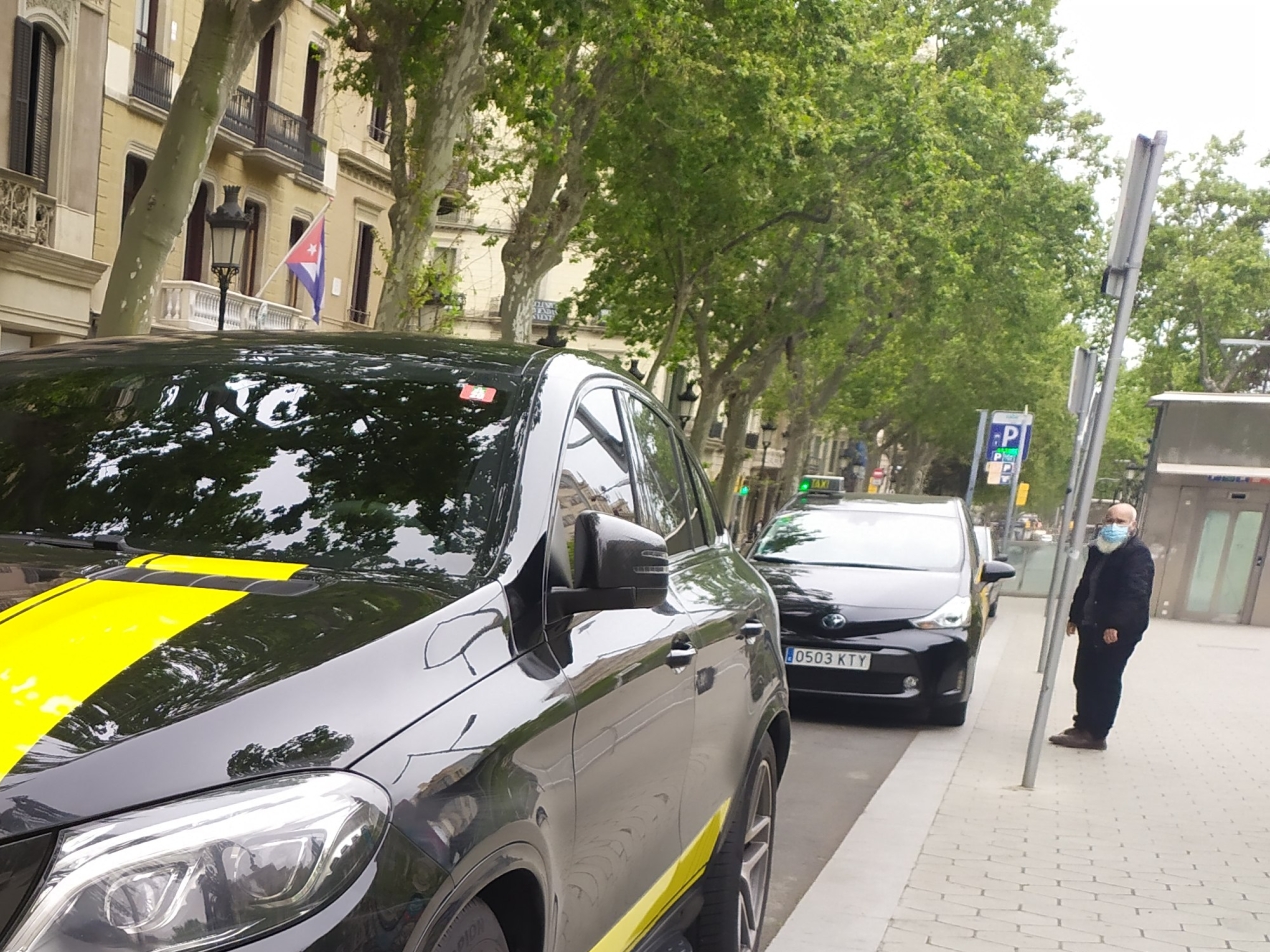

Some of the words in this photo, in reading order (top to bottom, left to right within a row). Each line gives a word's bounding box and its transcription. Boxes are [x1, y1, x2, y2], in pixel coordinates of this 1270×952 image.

[1002, 425, 1019, 448] P
[795, 650, 833, 665] 0503
[837, 653, 867, 667] KTY
